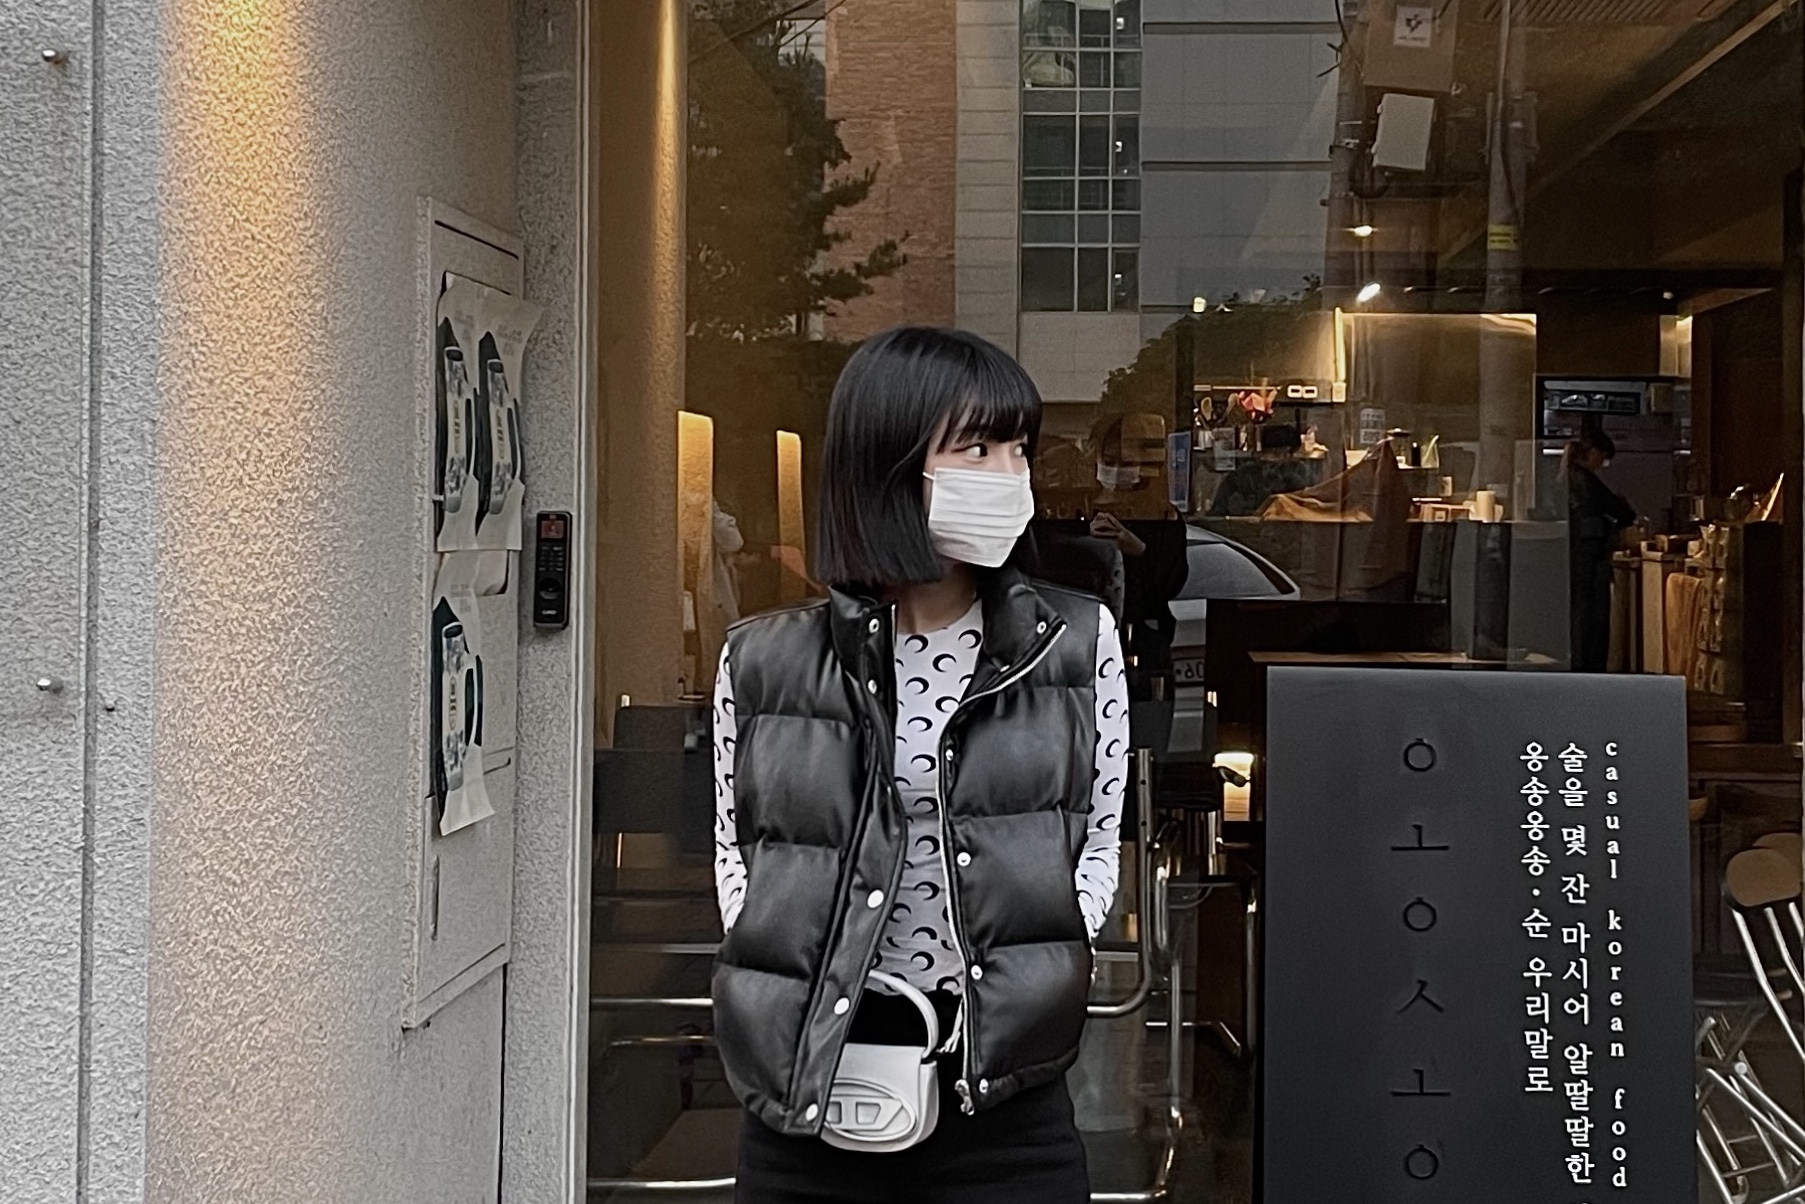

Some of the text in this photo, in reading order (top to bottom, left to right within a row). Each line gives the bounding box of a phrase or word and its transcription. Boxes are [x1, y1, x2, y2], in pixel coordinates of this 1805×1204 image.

[1558, 743, 1588, 806] 술을
[1605, 742, 1620, 879] casual
[1561, 825, 1587, 856] 몇
[1562, 874, 1590, 903] 잔
[1523, 957, 1553, 1091] 우리말로
[1562, 922, 1590, 1025] 마시어
[1608, 910, 1624, 1057] korean
[1564, 1043, 1595, 1183] 알딸딸한
[1612, 1089, 1627, 1187] food
